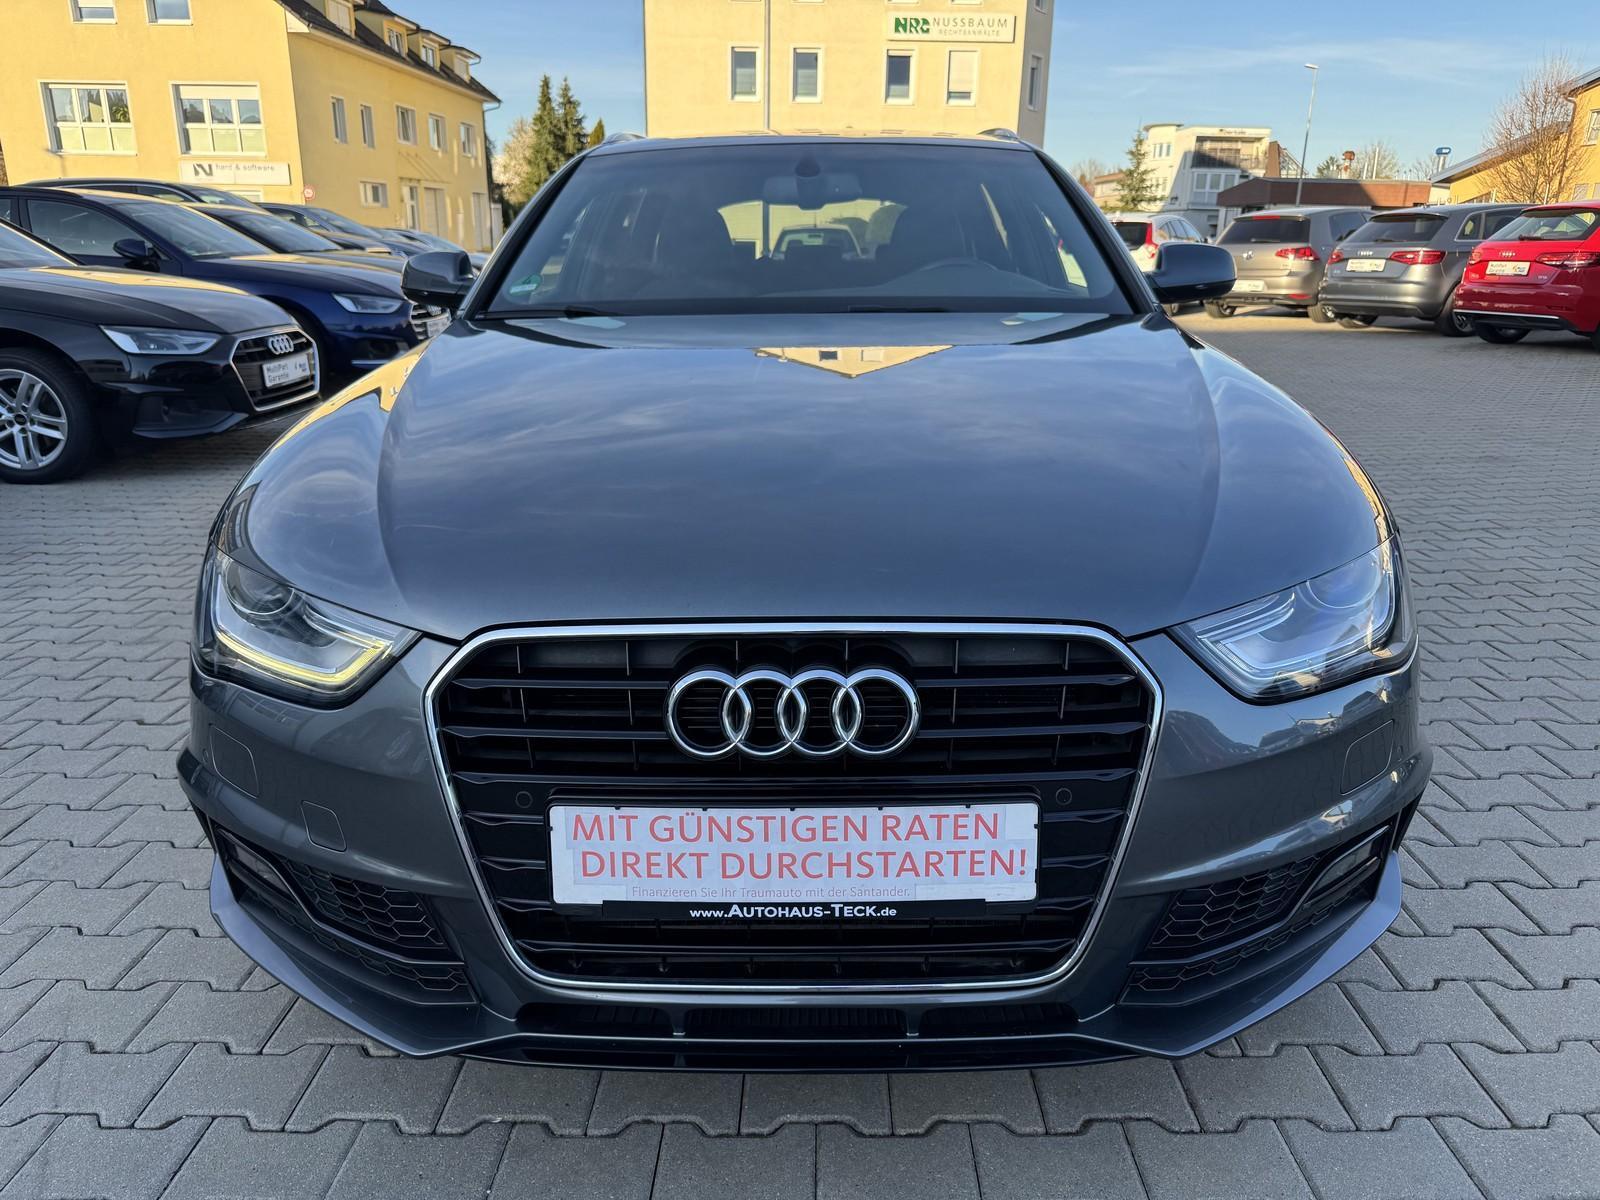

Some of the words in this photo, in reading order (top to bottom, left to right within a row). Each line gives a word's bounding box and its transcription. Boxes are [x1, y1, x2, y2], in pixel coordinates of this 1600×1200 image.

[932, 17, 1008, 29] NUSSBAUM
[572, 814, 638, 842] MIT
[649, 812, 867, 843] GÜNSTIGEN
[881, 813, 998, 841] RATEN
[581, 851, 709, 879] DIREKT
[720, 849, 1026, 879] DURCHSTARTEN!
[632, 886, 697, 898] Finanzieren
[700, 887, 718, 898] Sie
[721, 887, 737, 898] Ihr
[740, 887, 801, 898] Traumauto
[805, 887, 825, 898] mit
[828, 886, 847, 897] der
[850, 886, 911, 898] Santander.
